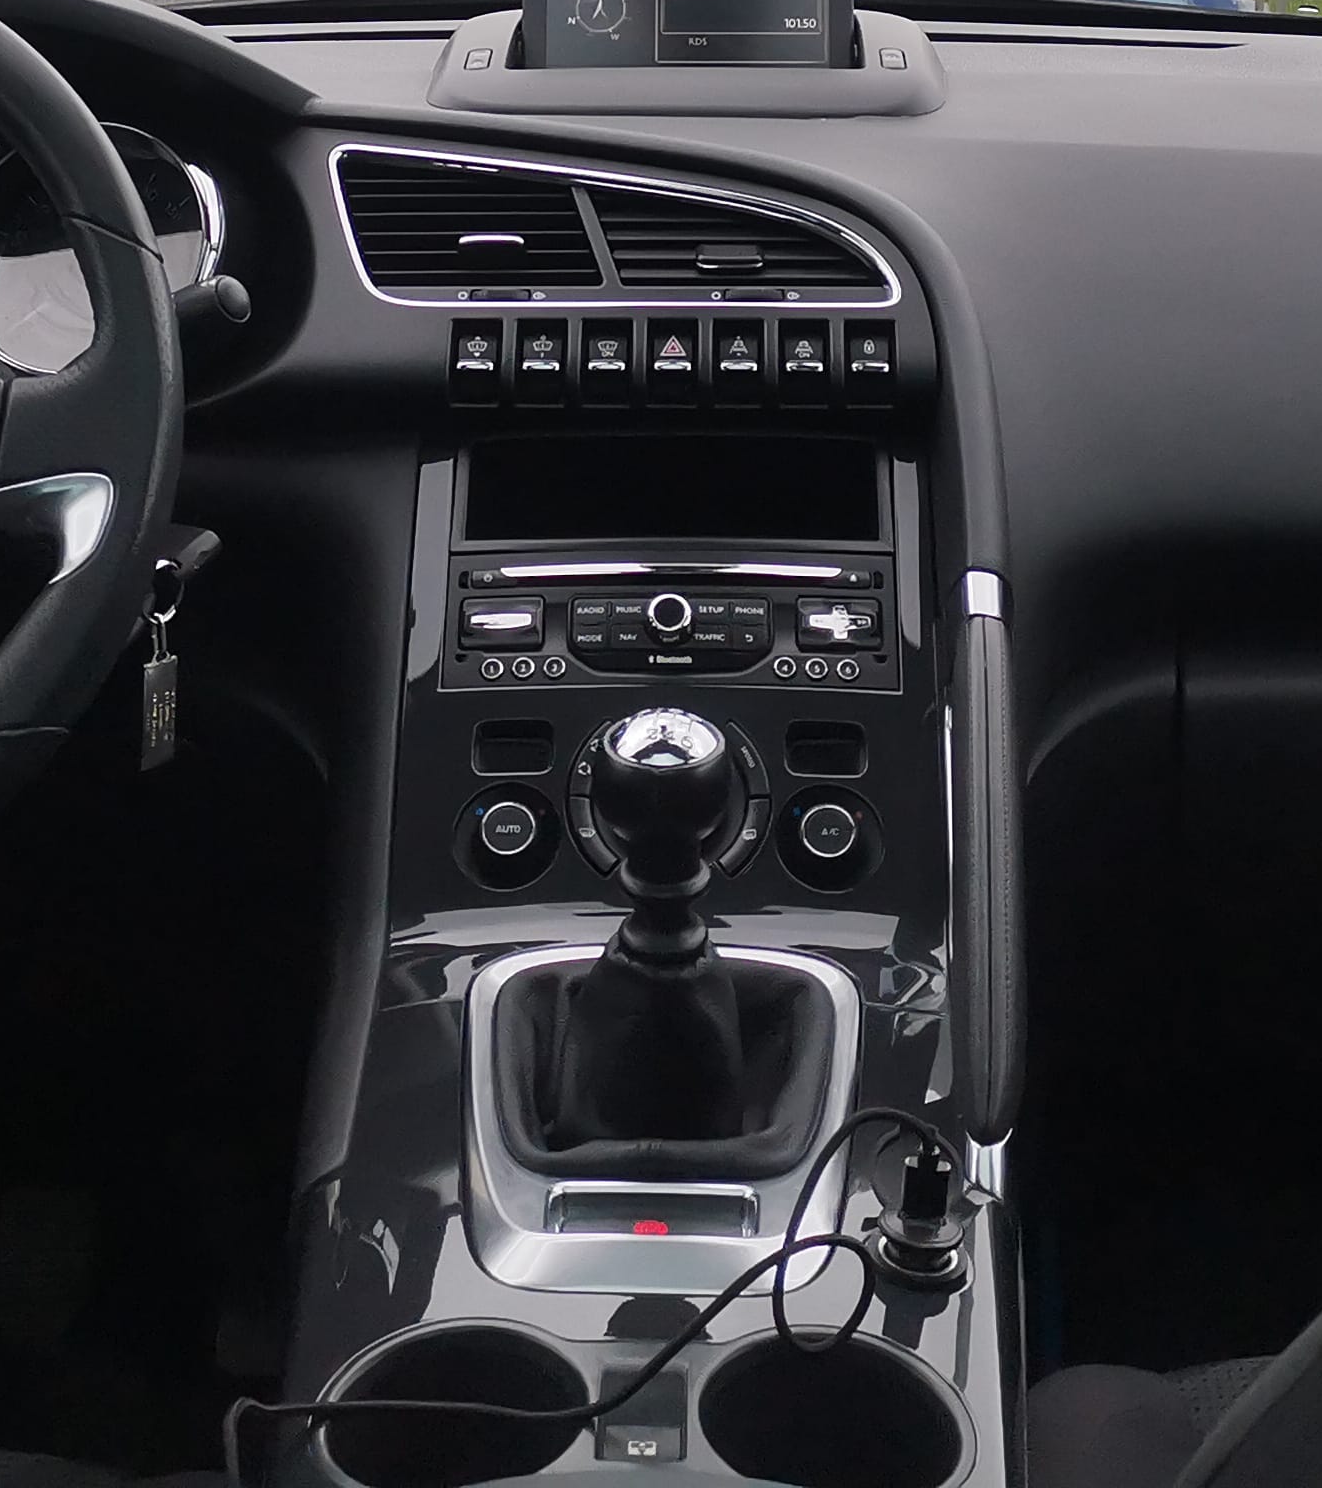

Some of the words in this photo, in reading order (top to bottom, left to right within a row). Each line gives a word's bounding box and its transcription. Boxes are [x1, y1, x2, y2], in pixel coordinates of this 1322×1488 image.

[567, 17, 576, 25] N
[784, 18, 817, 29] 101.50
[688, 37, 708, 46] RDS
[577, 607, 604, 615] RADIO
[616, 606, 641, 614] MUSIC
[735, 607, 764, 615] PHONE
[495, 825, 522, 834] AUTO
[821, 827, 840, 836] A/C
